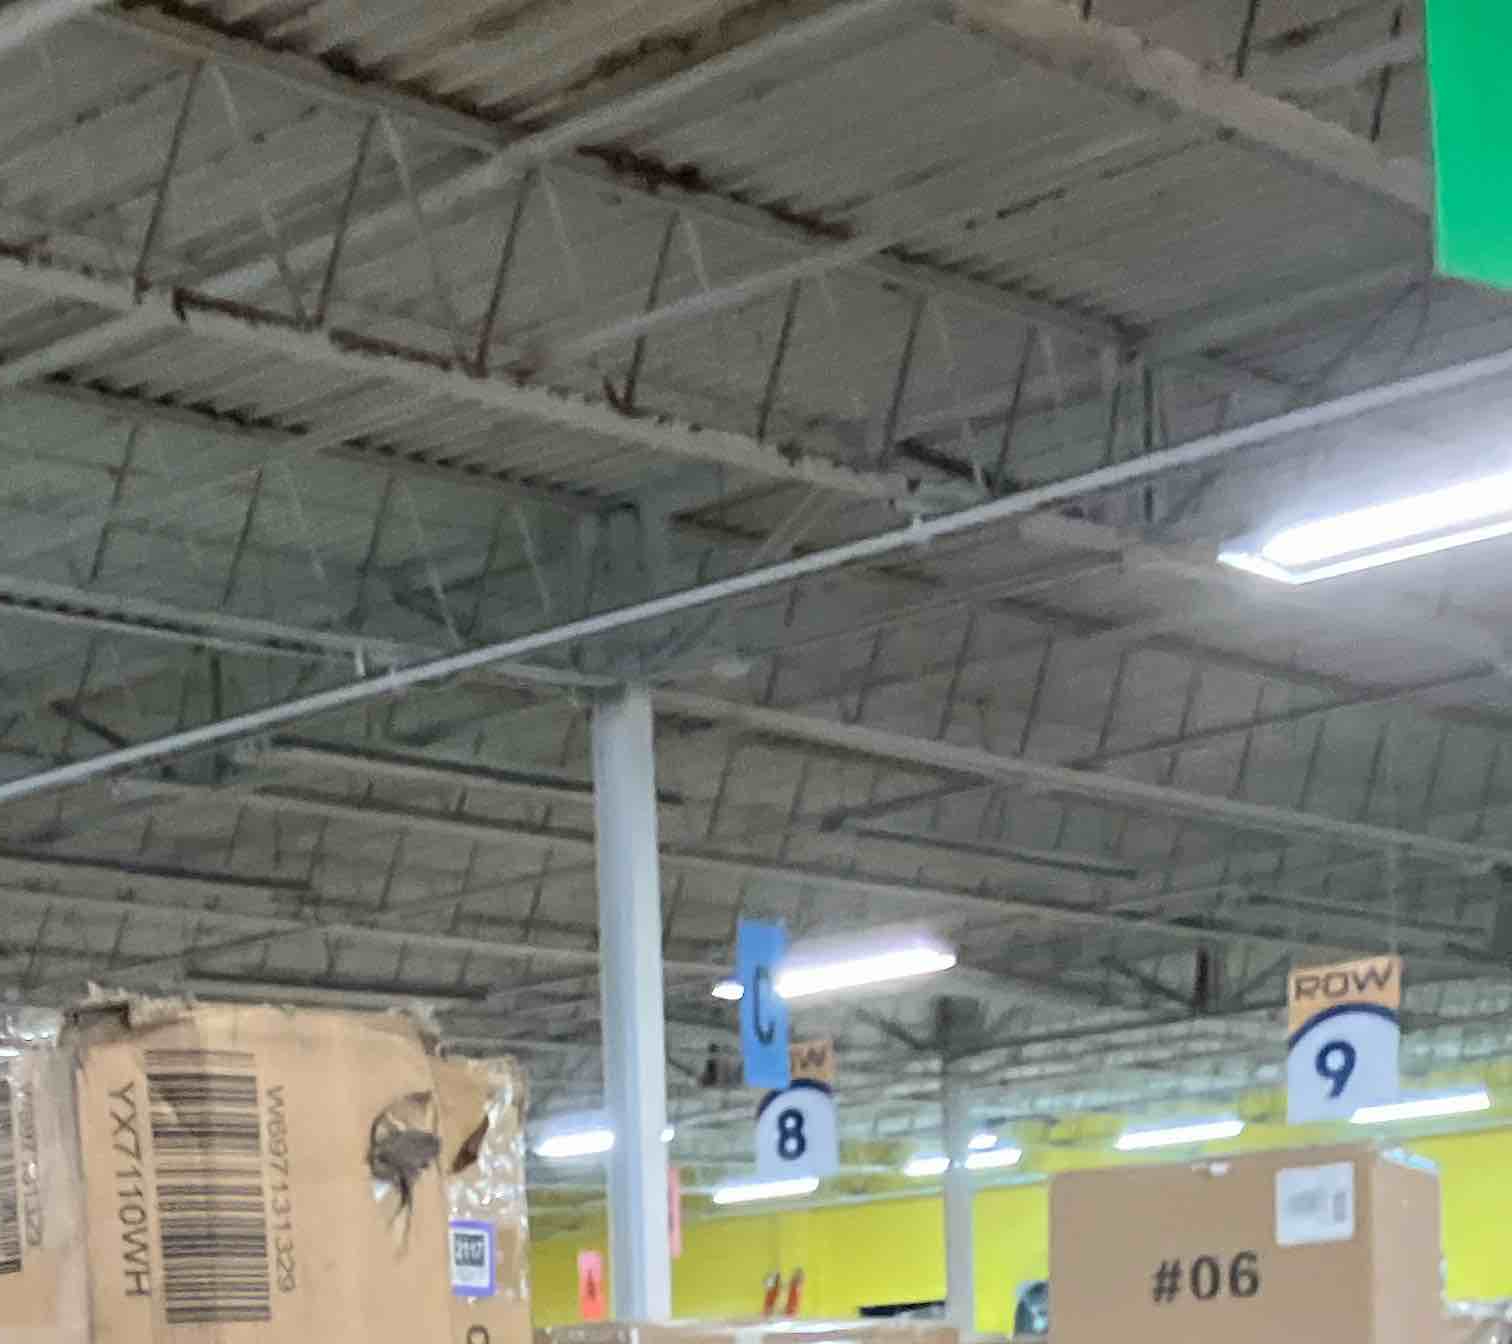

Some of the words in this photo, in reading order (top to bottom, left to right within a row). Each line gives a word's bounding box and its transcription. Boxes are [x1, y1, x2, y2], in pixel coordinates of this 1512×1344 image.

[1295, 963, 1393, 1000] ROW
[1315, 1040, 1357, 1099] 9
[777, 1108, 807, 1161] 8
[109, 1081, 152, 1297] YX7110WH
